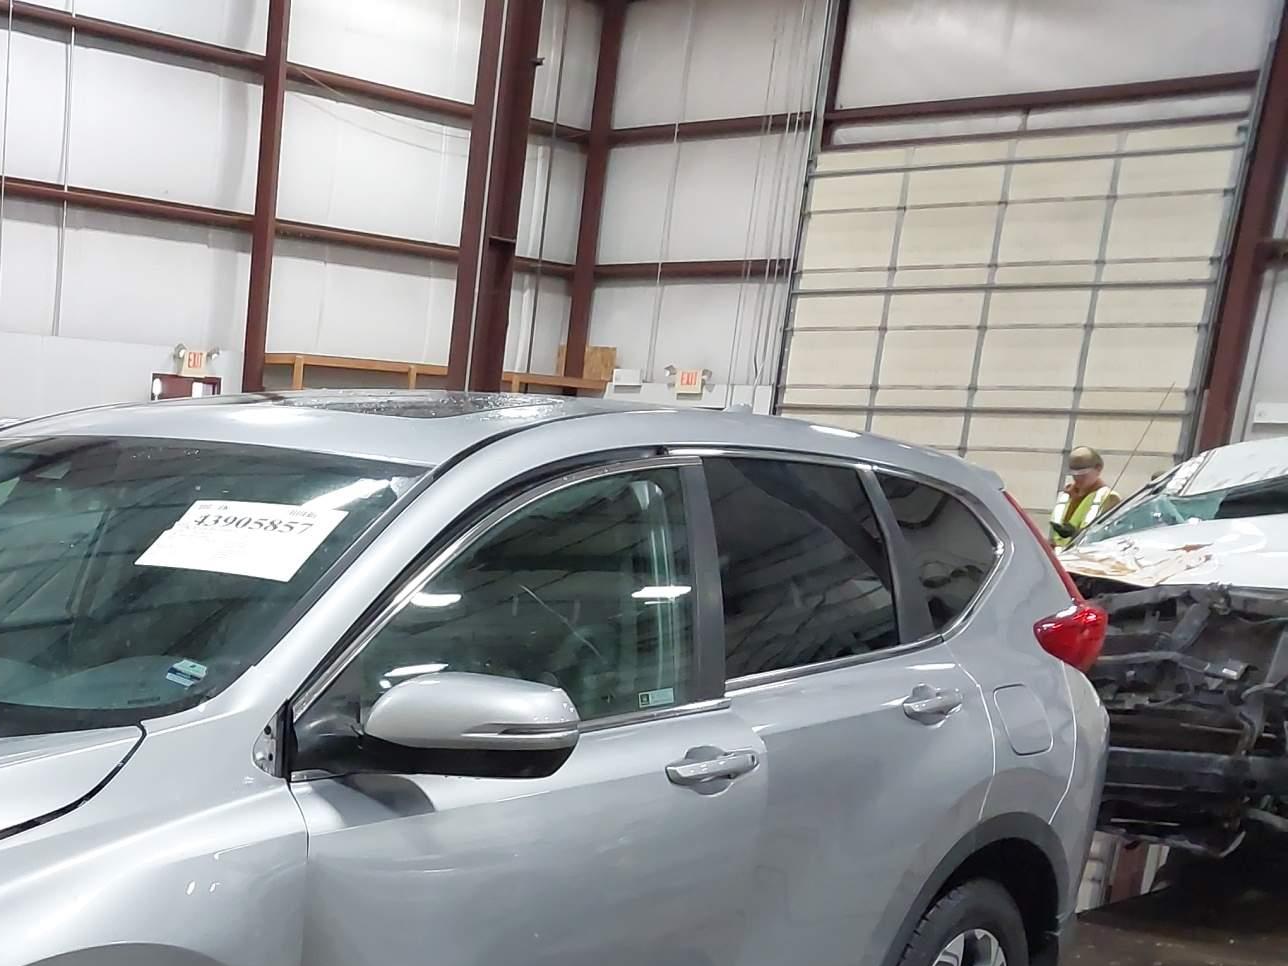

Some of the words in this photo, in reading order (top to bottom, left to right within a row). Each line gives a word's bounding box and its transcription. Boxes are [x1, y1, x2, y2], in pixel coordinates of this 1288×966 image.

[188, 352, 203, 368] EXIT
[680, 371, 698, 386] EXIT
[193, 514, 314, 535] 43905857
